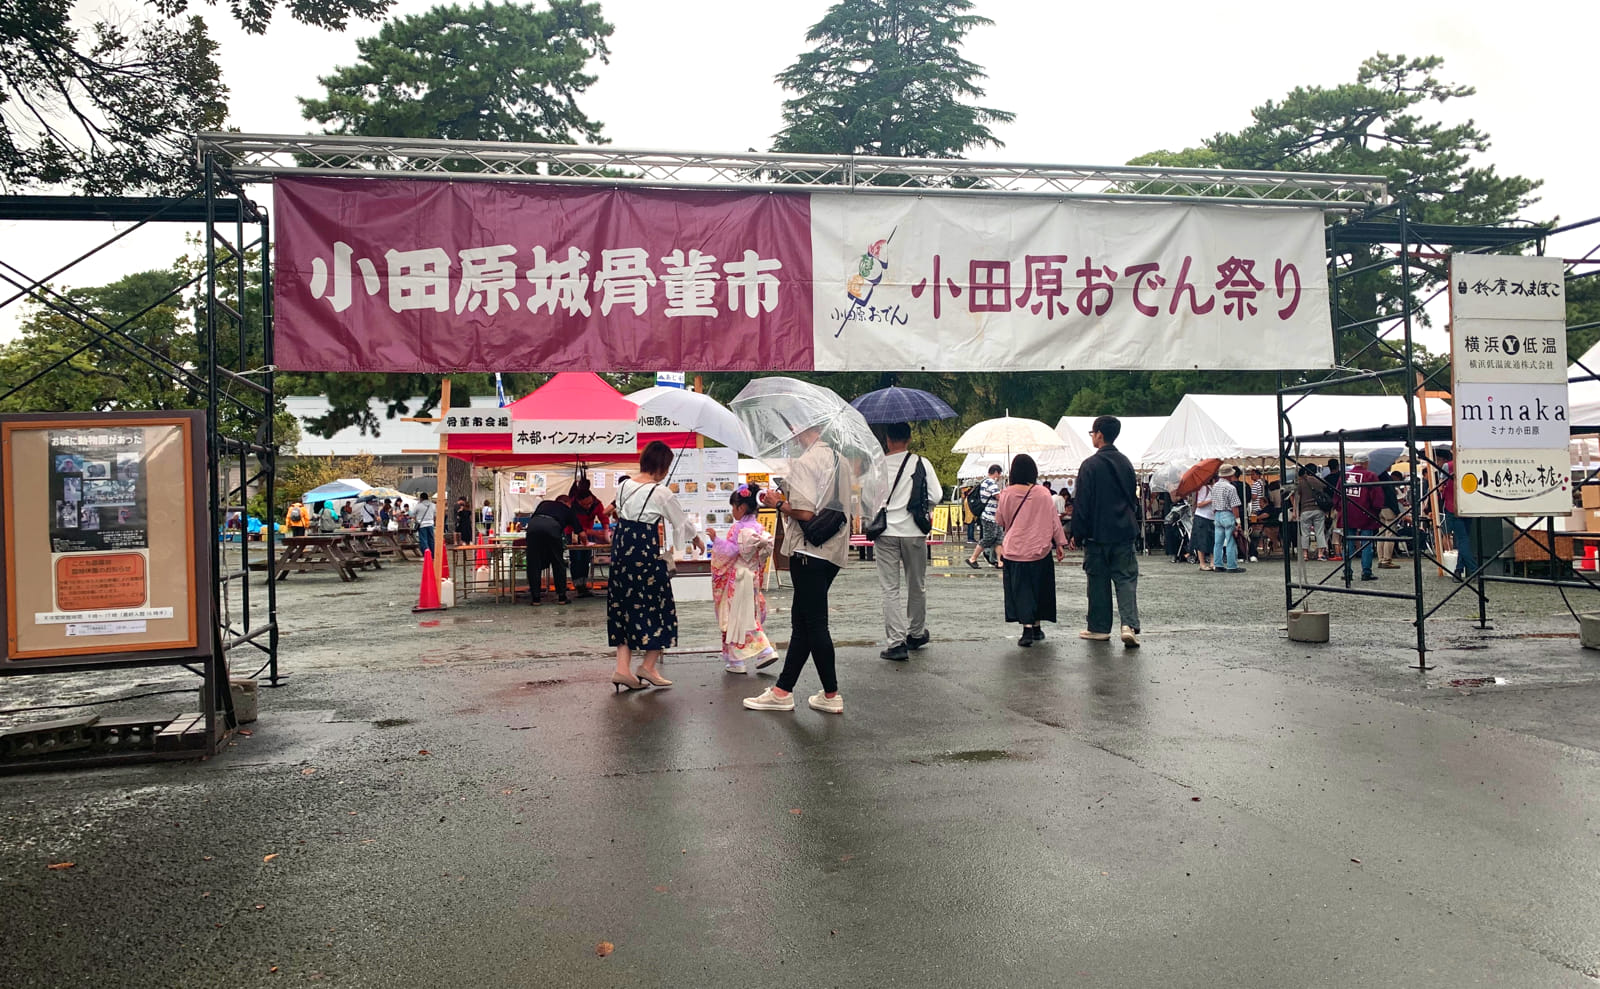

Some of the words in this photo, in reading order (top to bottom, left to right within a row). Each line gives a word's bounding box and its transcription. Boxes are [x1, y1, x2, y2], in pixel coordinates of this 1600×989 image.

[309, 241, 783, 318] 小田原城骨董市
[911, 254, 1301, 321] 小田原おでん祭り
[1469, 359, 1554, 370] 横浜低温流通株式会社
[1461, 396, 1566, 421] minaka
[446, 416, 509, 427] 骨董市会場
[1490, 426, 1540, 435] ミナカ小田原
[51, 435, 142, 447] お城に動物園があった
[516, 430, 635, 445] 本部・インフォメーション
